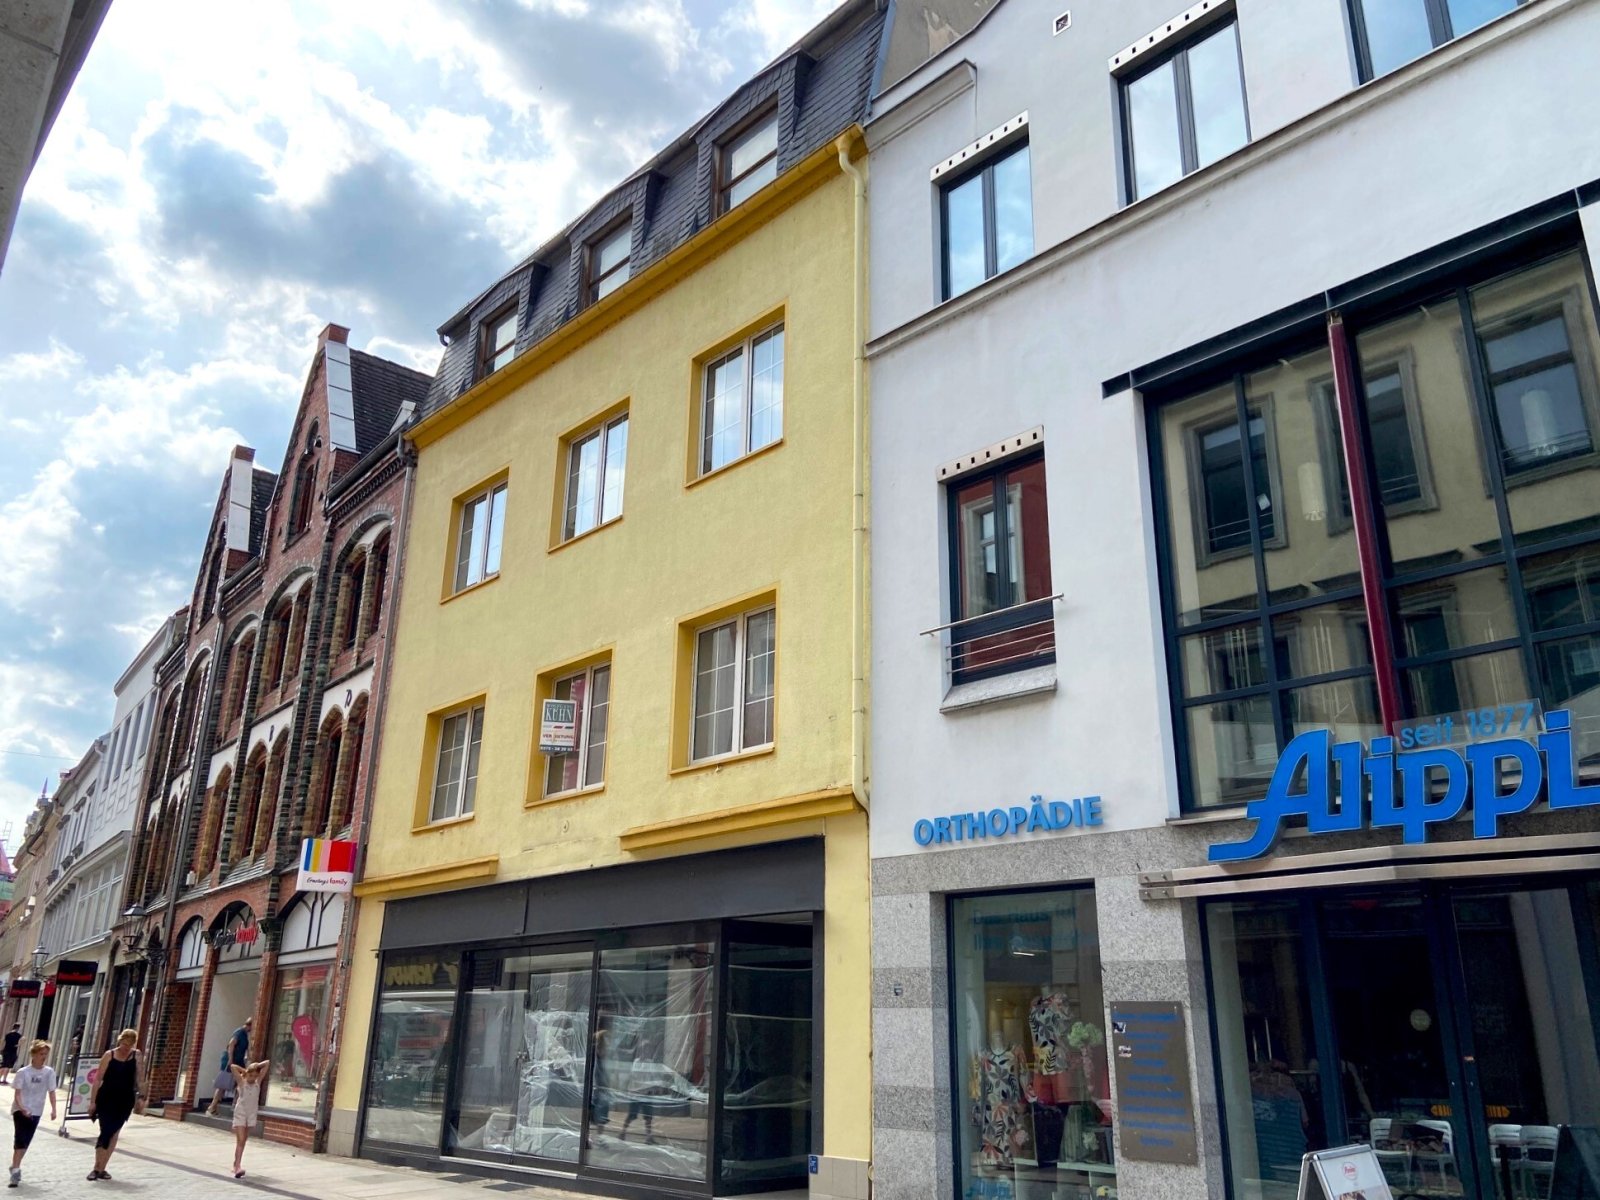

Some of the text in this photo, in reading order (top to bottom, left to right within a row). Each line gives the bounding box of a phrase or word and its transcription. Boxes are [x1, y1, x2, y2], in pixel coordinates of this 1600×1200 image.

[1401, 701, 1535, 748] seit 1877
[1208, 709, 1600, 861] Alippi
[914, 795, 1104, 846] ORTHOPÄDIE
[329, 876, 348, 886] family
